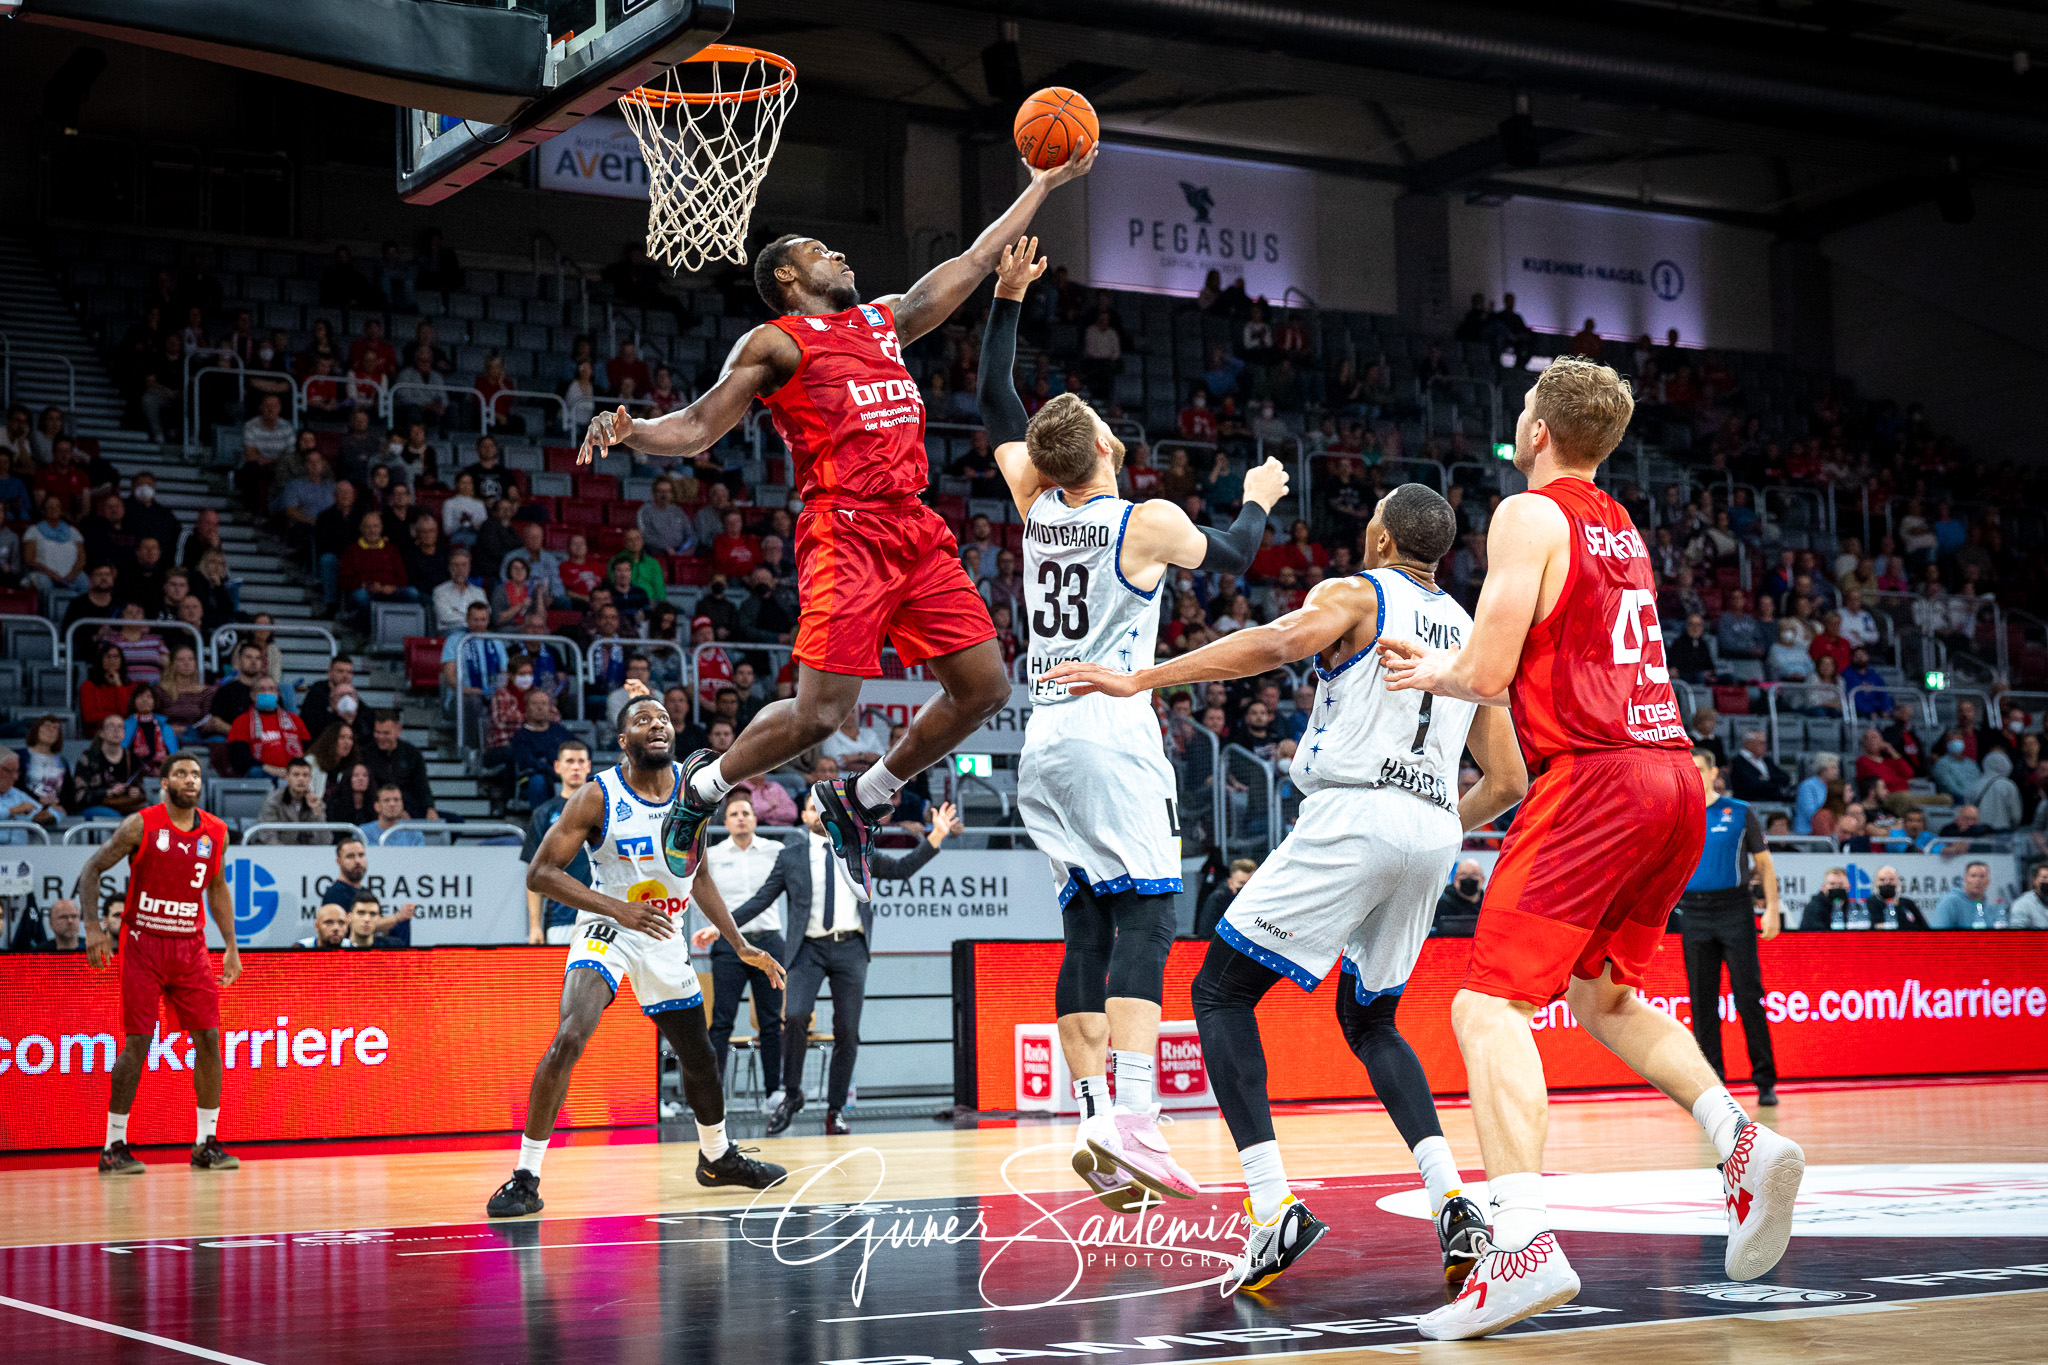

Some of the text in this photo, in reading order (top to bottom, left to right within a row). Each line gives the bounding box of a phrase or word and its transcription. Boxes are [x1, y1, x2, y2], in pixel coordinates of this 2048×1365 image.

[1128, 217, 1280, 264] PEGASUS
[864, 421, 879, 432] der
[1024, 518, 1110, 548] MIDTGAARD
[1032, 561, 1090, 640] 33
[1413, 610, 1462, 650] LEWIS
[1610, 588, 1670, 685] 43
[1411, 691, 1434, 756] 1
[189, 862, 208, 889] 3
[301, 875, 473, 899] IGRASHI
[414, 904, 473, 920] GMBH
[958, 903, 1009, 918] GMBH
[1254, 916, 1288, 940] HAKRO
[1024, 1041, 1050, 1062] RHÖN
[1160, 1040, 1202, 1060] RHÖN
